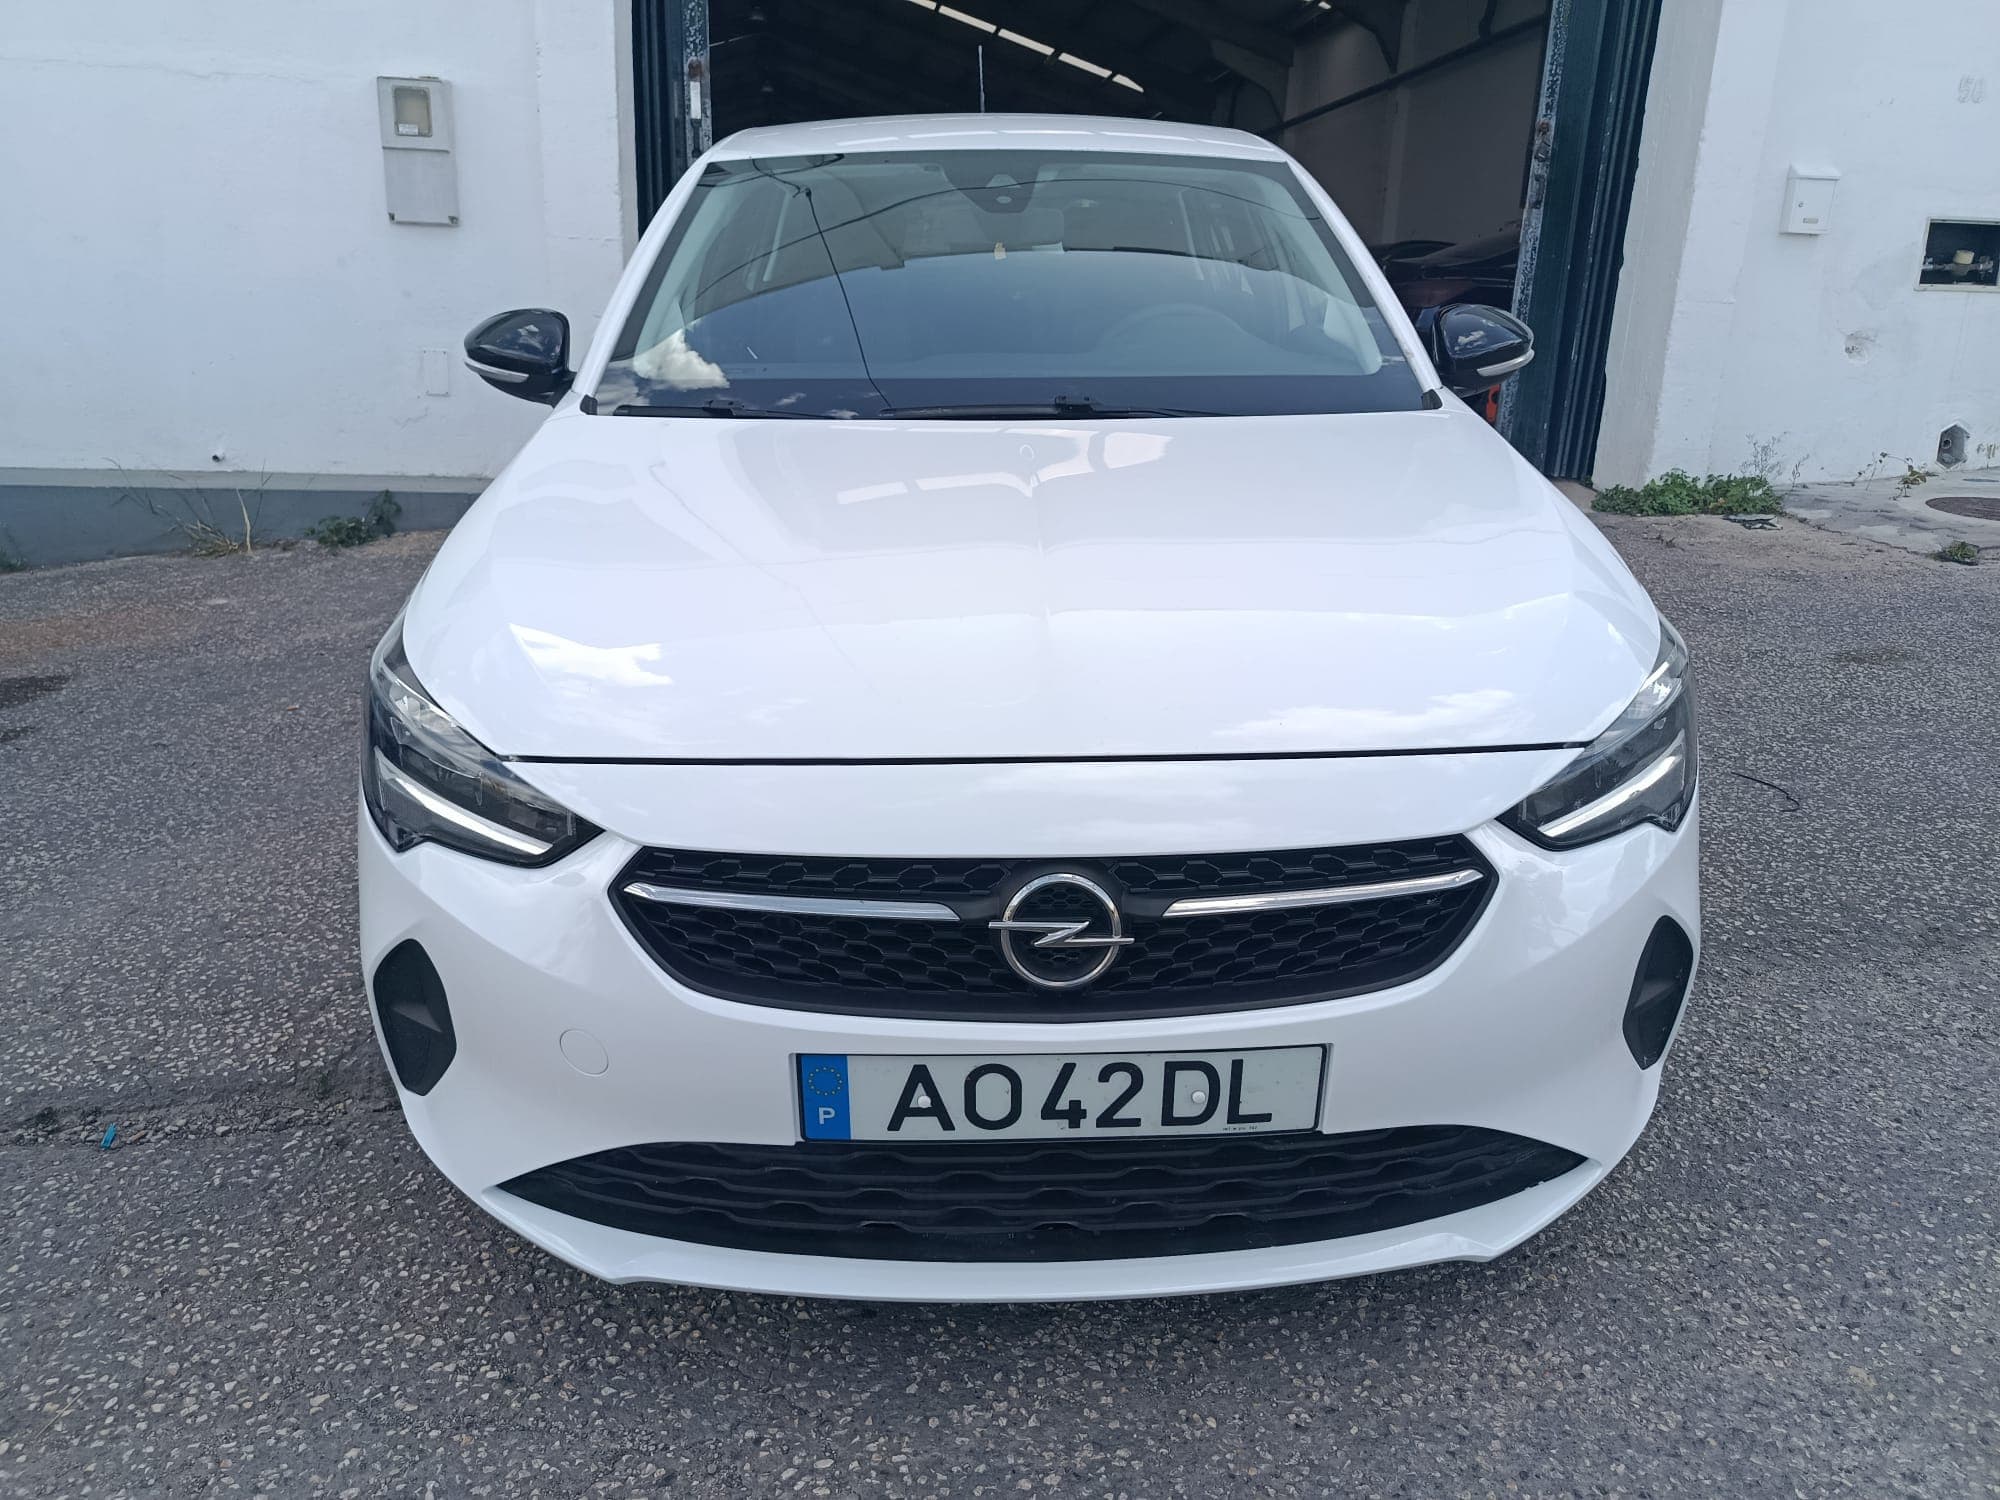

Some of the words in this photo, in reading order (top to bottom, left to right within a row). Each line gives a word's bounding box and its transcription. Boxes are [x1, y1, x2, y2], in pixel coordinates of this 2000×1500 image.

[818, 1107, 836, 1125] P
[887, 1063, 1022, 1131] AO
[1041, 1062, 1144, 1129] 42
[1161, 1059, 1273, 1126] DL
